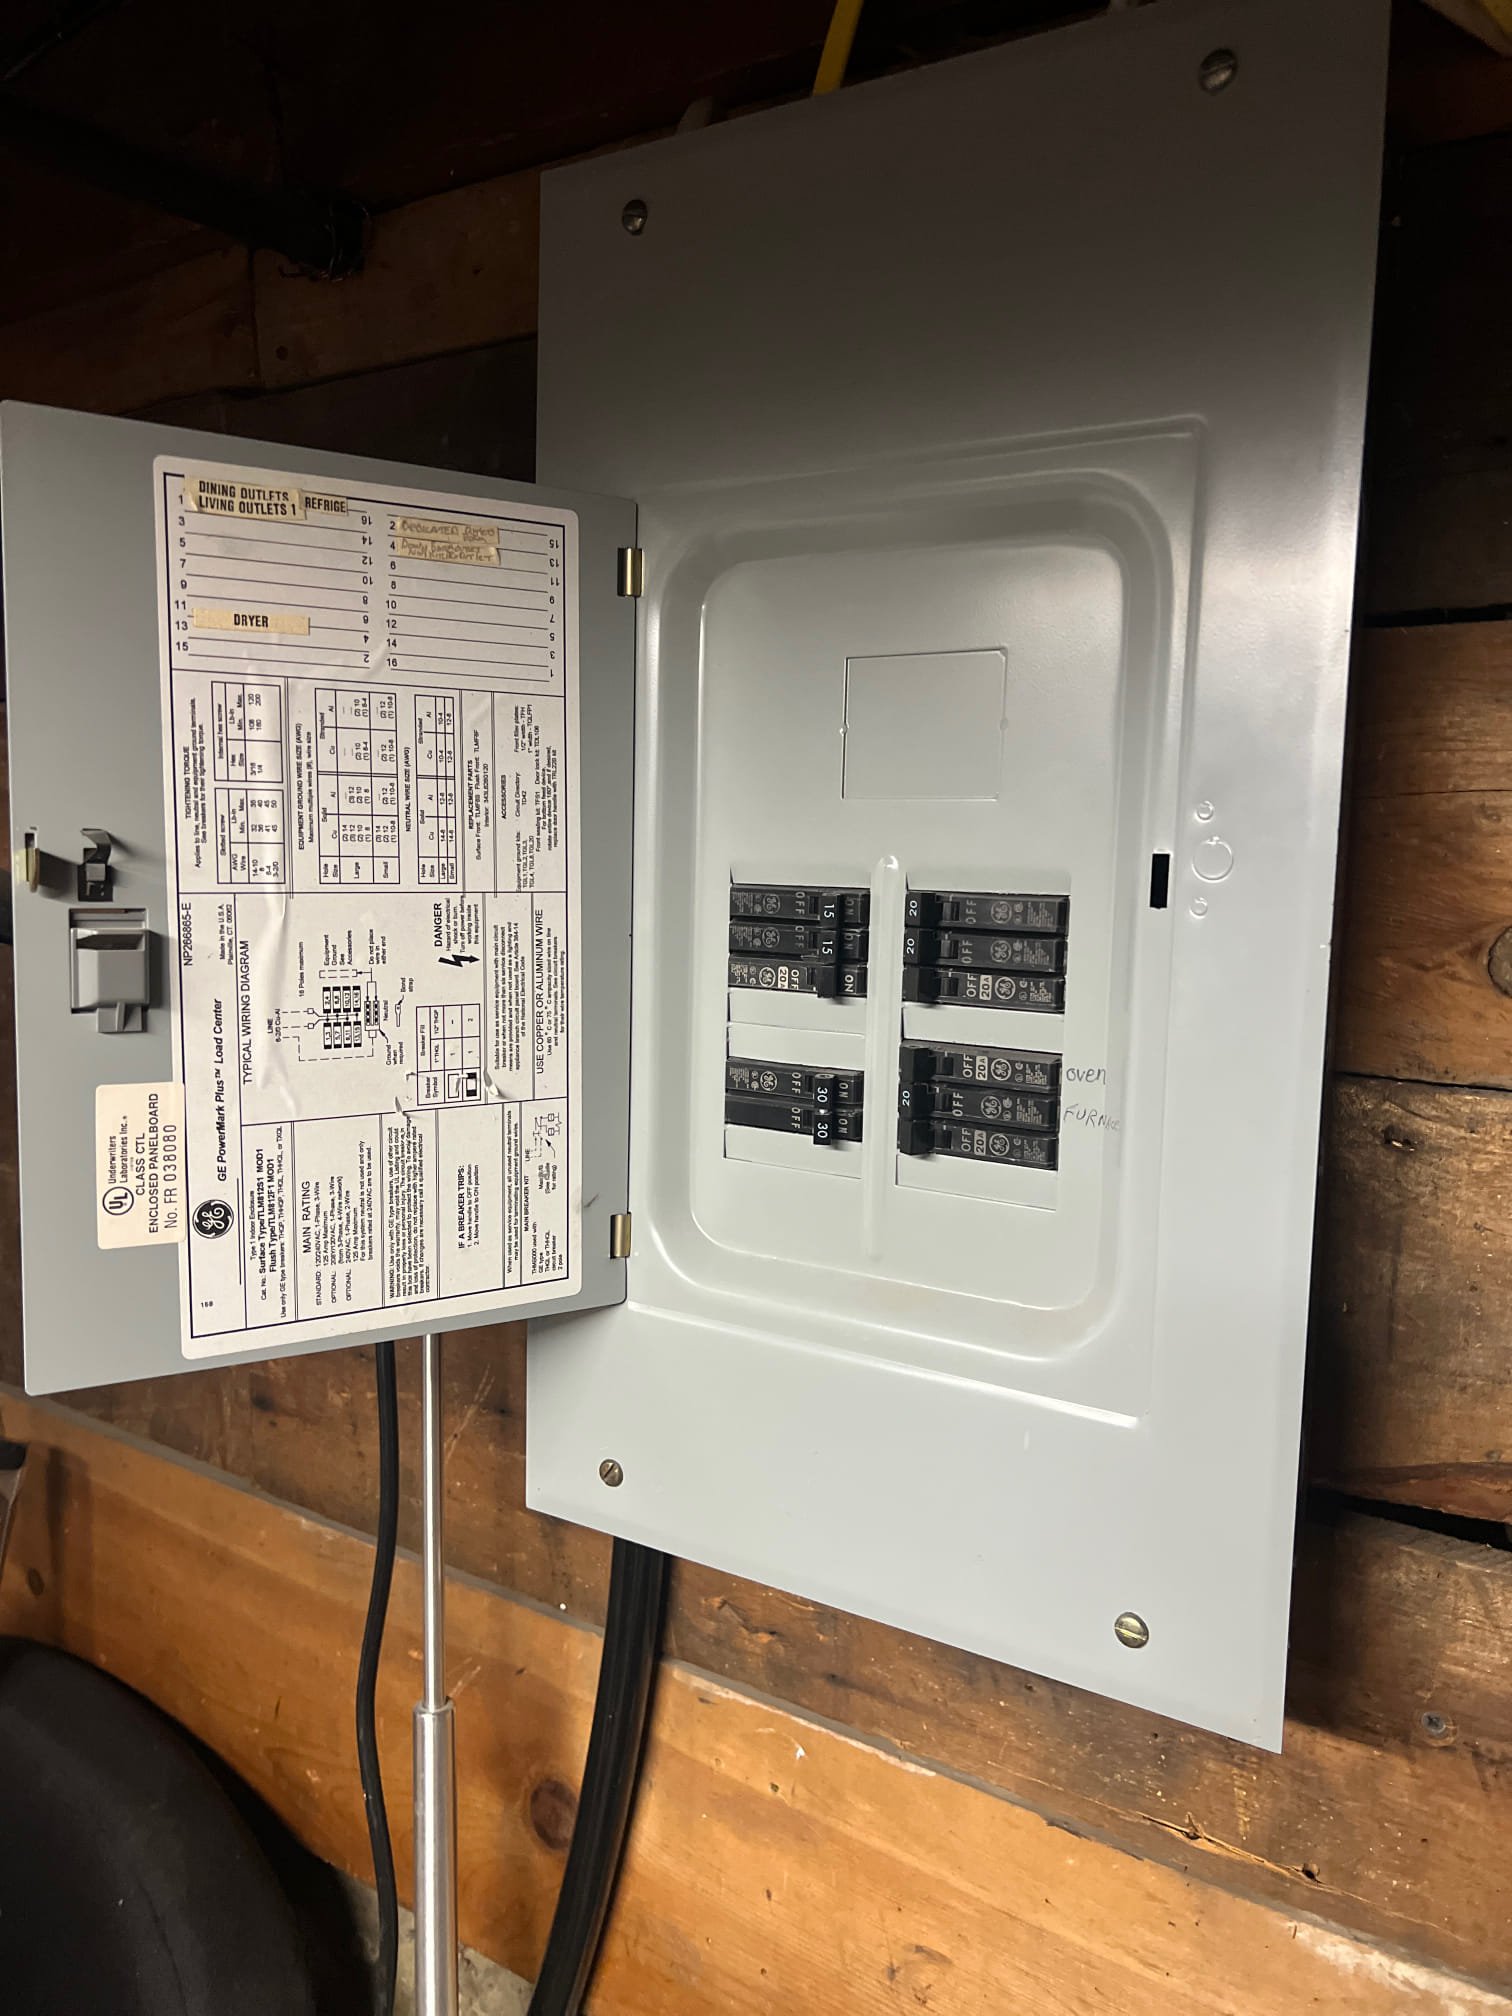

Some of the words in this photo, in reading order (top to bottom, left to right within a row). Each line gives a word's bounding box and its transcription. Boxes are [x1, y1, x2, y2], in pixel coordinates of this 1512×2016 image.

[199, 481, 236, 498] DINING
[178, 496, 183, 504] 1
[199, 496, 234, 512] LIVING
[239, 500, 288, 516] OUTLETS
[292, 504, 296, 515] 1
[305, 497, 346, 513] REFRIGE
[179, 517, 185, 525] 3
[390, 522, 396, 530] 2
[180, 538, 186, 547] 5
[362, 536, 372, 545] 14
[390, 541, 396, 550] 4
[550, 539, 559, 548] 15
[180, 559, 186, 568] 7
[362, 556, 372, 564] 12
[550, 559, 559, 567] 13
[362, 576, 373, 584] 10
[550, 577, 559, 586] 11
[175, 600, 186, 609] 11
[386, 600, 396, 609] 10
[175, 622, 188, 630] 13
[234, 614, 269, 628] DRYER
[386, 620, 397, 628] 12
[176, 642, 188, 650] 15
[387, 639, 397, 648] 14
[295, 723, 303, 743] (AWG)
[795, 892, 805, 915] OFF
[824, 904, 834, 918] 15
[909, 900, 918, 917] 20
[965, 900, 976, 924] OFF
[434, 903, 443, 947] DANGER
[535, 909, 543, 937] WIRE
[182, 903, 193, 966] NP266865-E
[822, 940, 833, 955] 15
[907, 938, 914, 954] 20
[961, 939, 973, 964] OFF
[240, 940, 250, 992] DIAGRAM
[535, 938, 544, 990] ALUMINUM
[791, 970, 799, 989] OFF
[845, 975, 854, 992] ON
[967, 974, 976, 997] OFF
[980, 977, 991, 999] 20A
[536, 992, 544, 1008] OR
[213, 999, 223, 1034] Center
[241, 994, 251, 1036] WIRING
[536, 1010, 544, 1052] COPPER
[214, 1038, 224, 1064] Load
[242, 1039, 253, 1085] TYPICAL
[536, 1054, 544, 1074] USE
[963, 1054, 973, 1077] OFF
[977, 1058, 987, 1080] 20A
[792, 1072, 801, 1094] OFF
[1066, 1068, 1106, 1085] oven
[817, 1087, 828, 1103] 30
[840, 1083, 848, 1098] ON
[902, 1090, 910, 1106] 20
[952, 1092, 963, 1117] OFF
[792, 1107, 800, 1129] OFF
[838, 1119, 848, 1134] ON
[148, 1094, 158, 1169] PANELBOARD
[214, 1105, 226, 1163] PowerMark
[817, 1123, 828, 1138] 30
[961, 1128, 971, 1152] OFF
[136, 1133, 145, 1154] CTL
[975, 1133, 985, 1154] 20A
[108, 1136, 117, 1184] Underwriters
[119, 1136, 128, 1183] Laboratories
[163, 1125, 177, 1182] 038080
[136, 1158, 145, 1195] CLASS
[217, 1166, 227, 1182] GE
[109, 1192, 128, 1210] UL
[149, 1173, 159, 1233] ENCLOSED
[164, 1188, 177, 1203] FR
[302, 1181, 311, 1221] RATING
[164, 1208, 177, 1228] No.
[302, 1227, 312, 1253] MAIN
[257, 1243, 266, 1274] Surface
